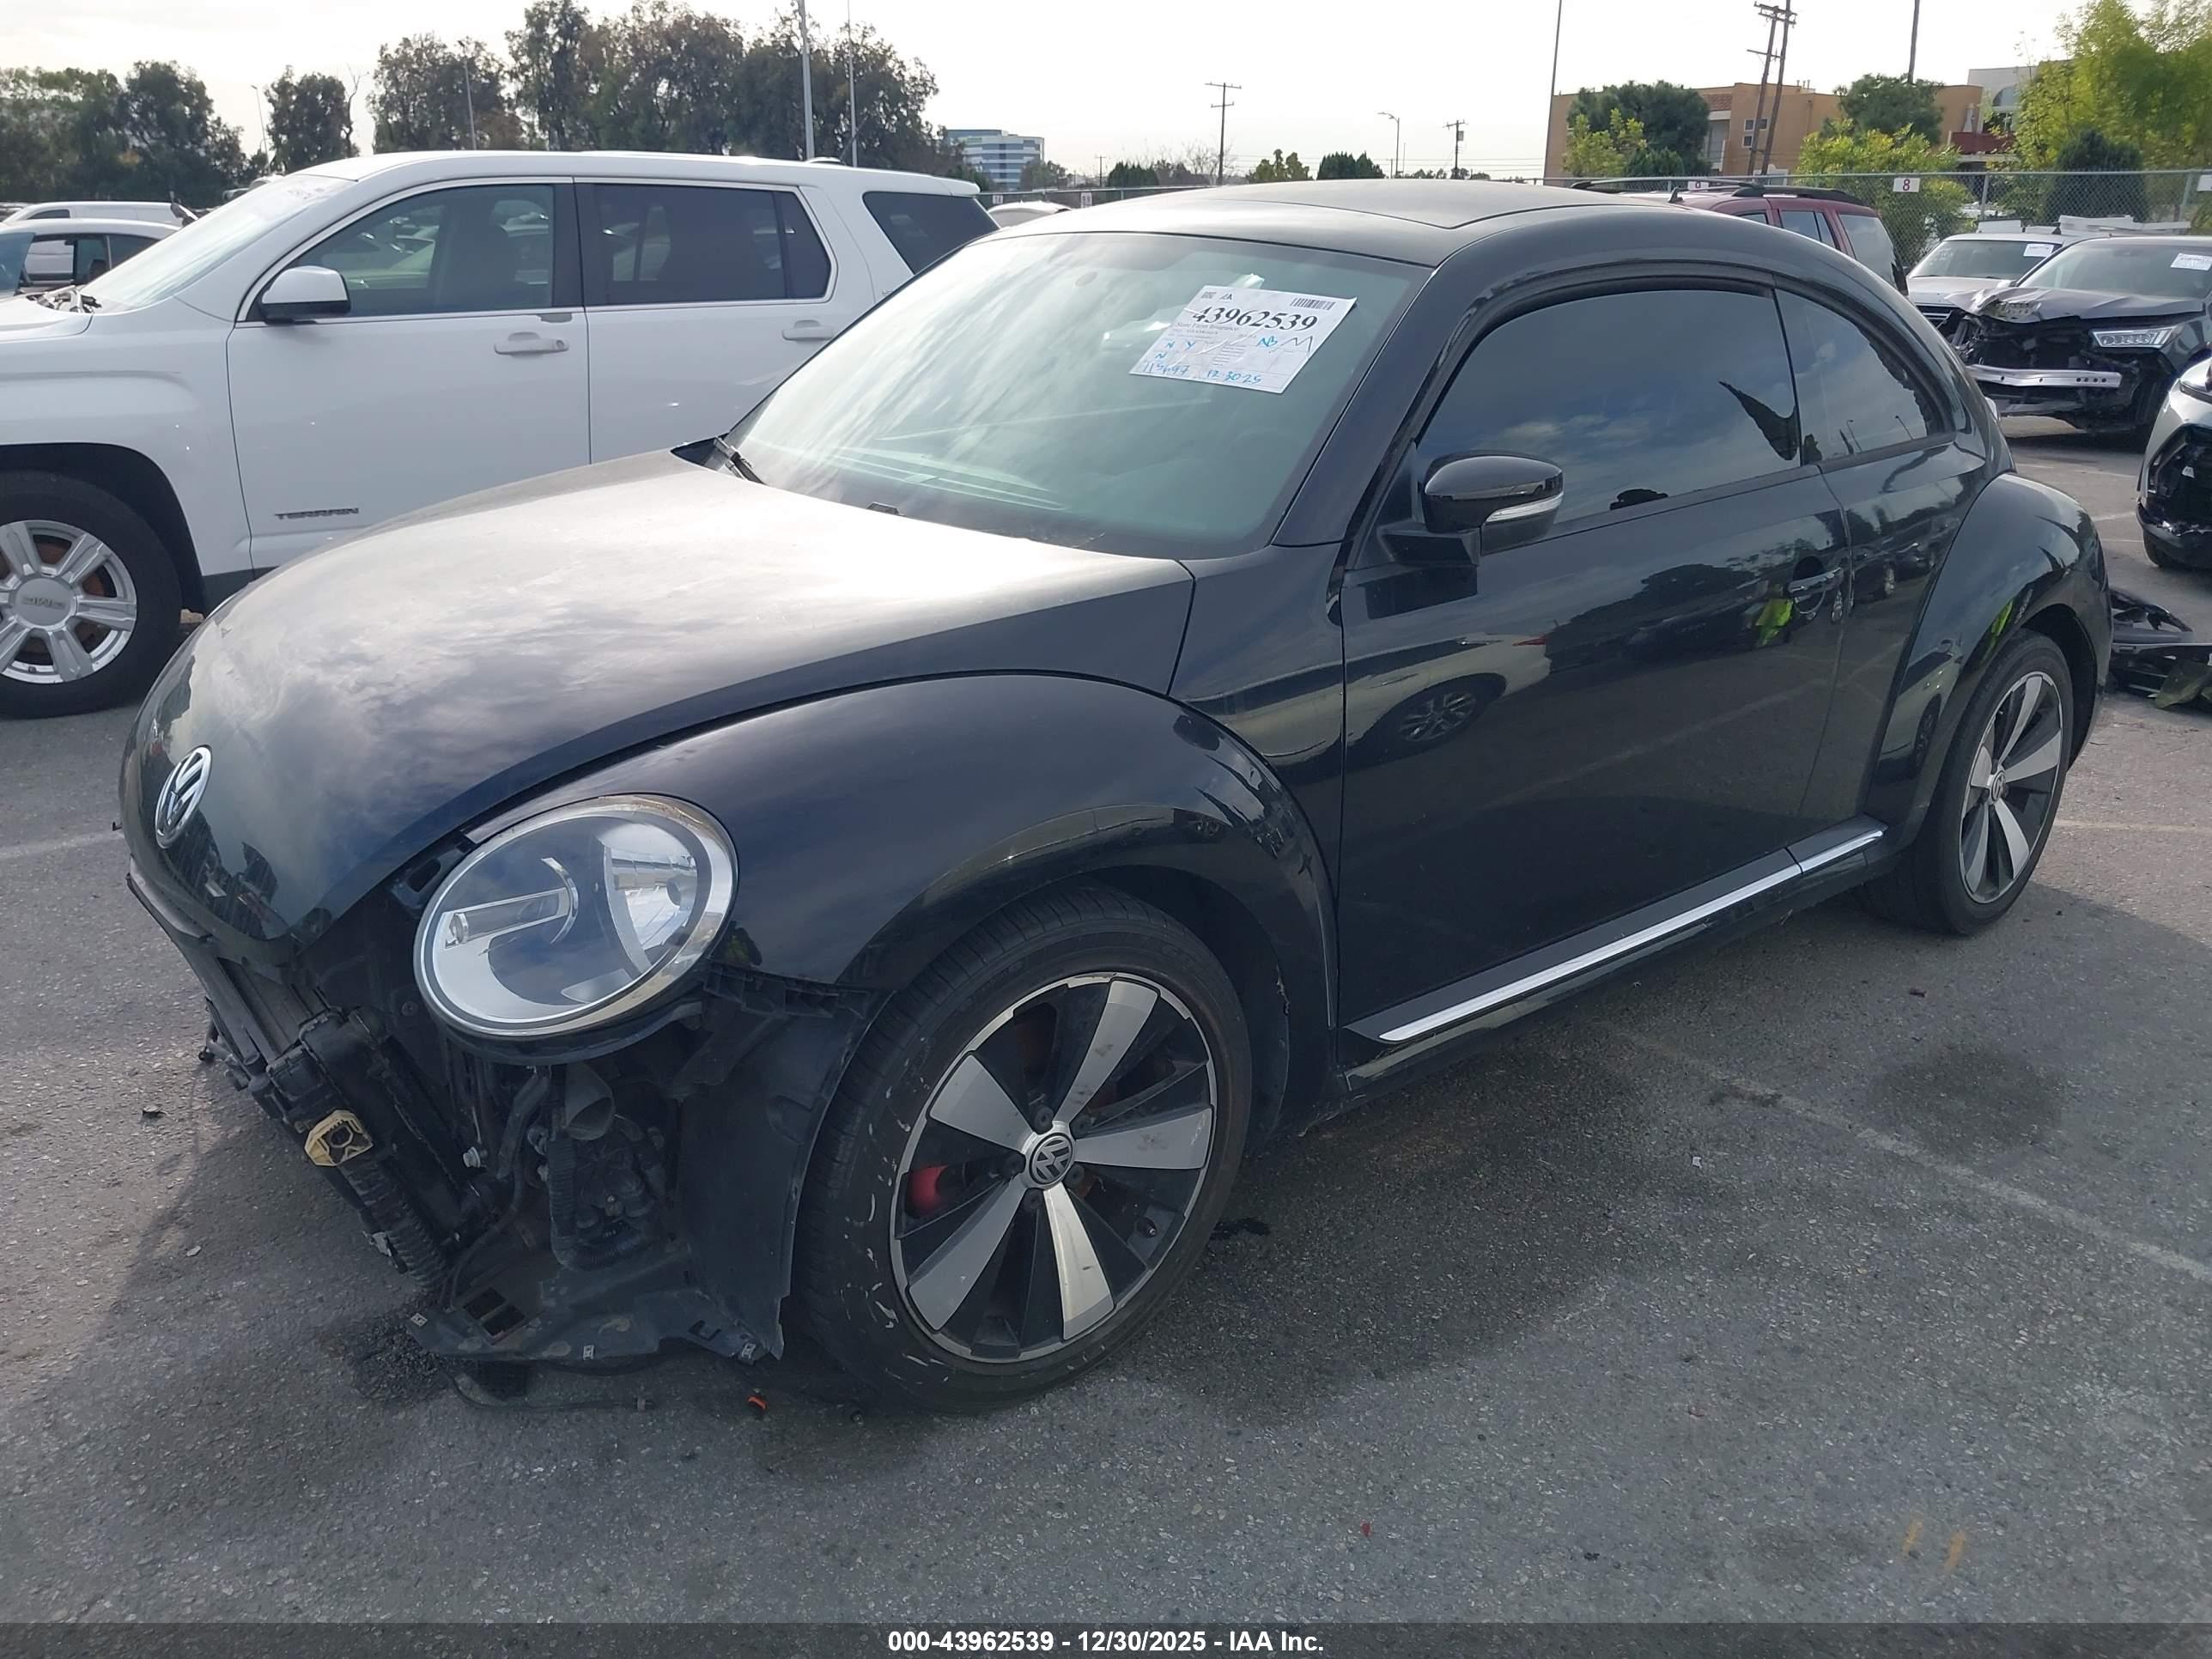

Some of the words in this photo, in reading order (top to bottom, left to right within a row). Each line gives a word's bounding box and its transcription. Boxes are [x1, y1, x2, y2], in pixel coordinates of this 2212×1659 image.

[1902, 179, 1911, 191] 8
[1192, 306, 1318, 331] 43962539
[274, 507, 359, 520] TERRAIN
